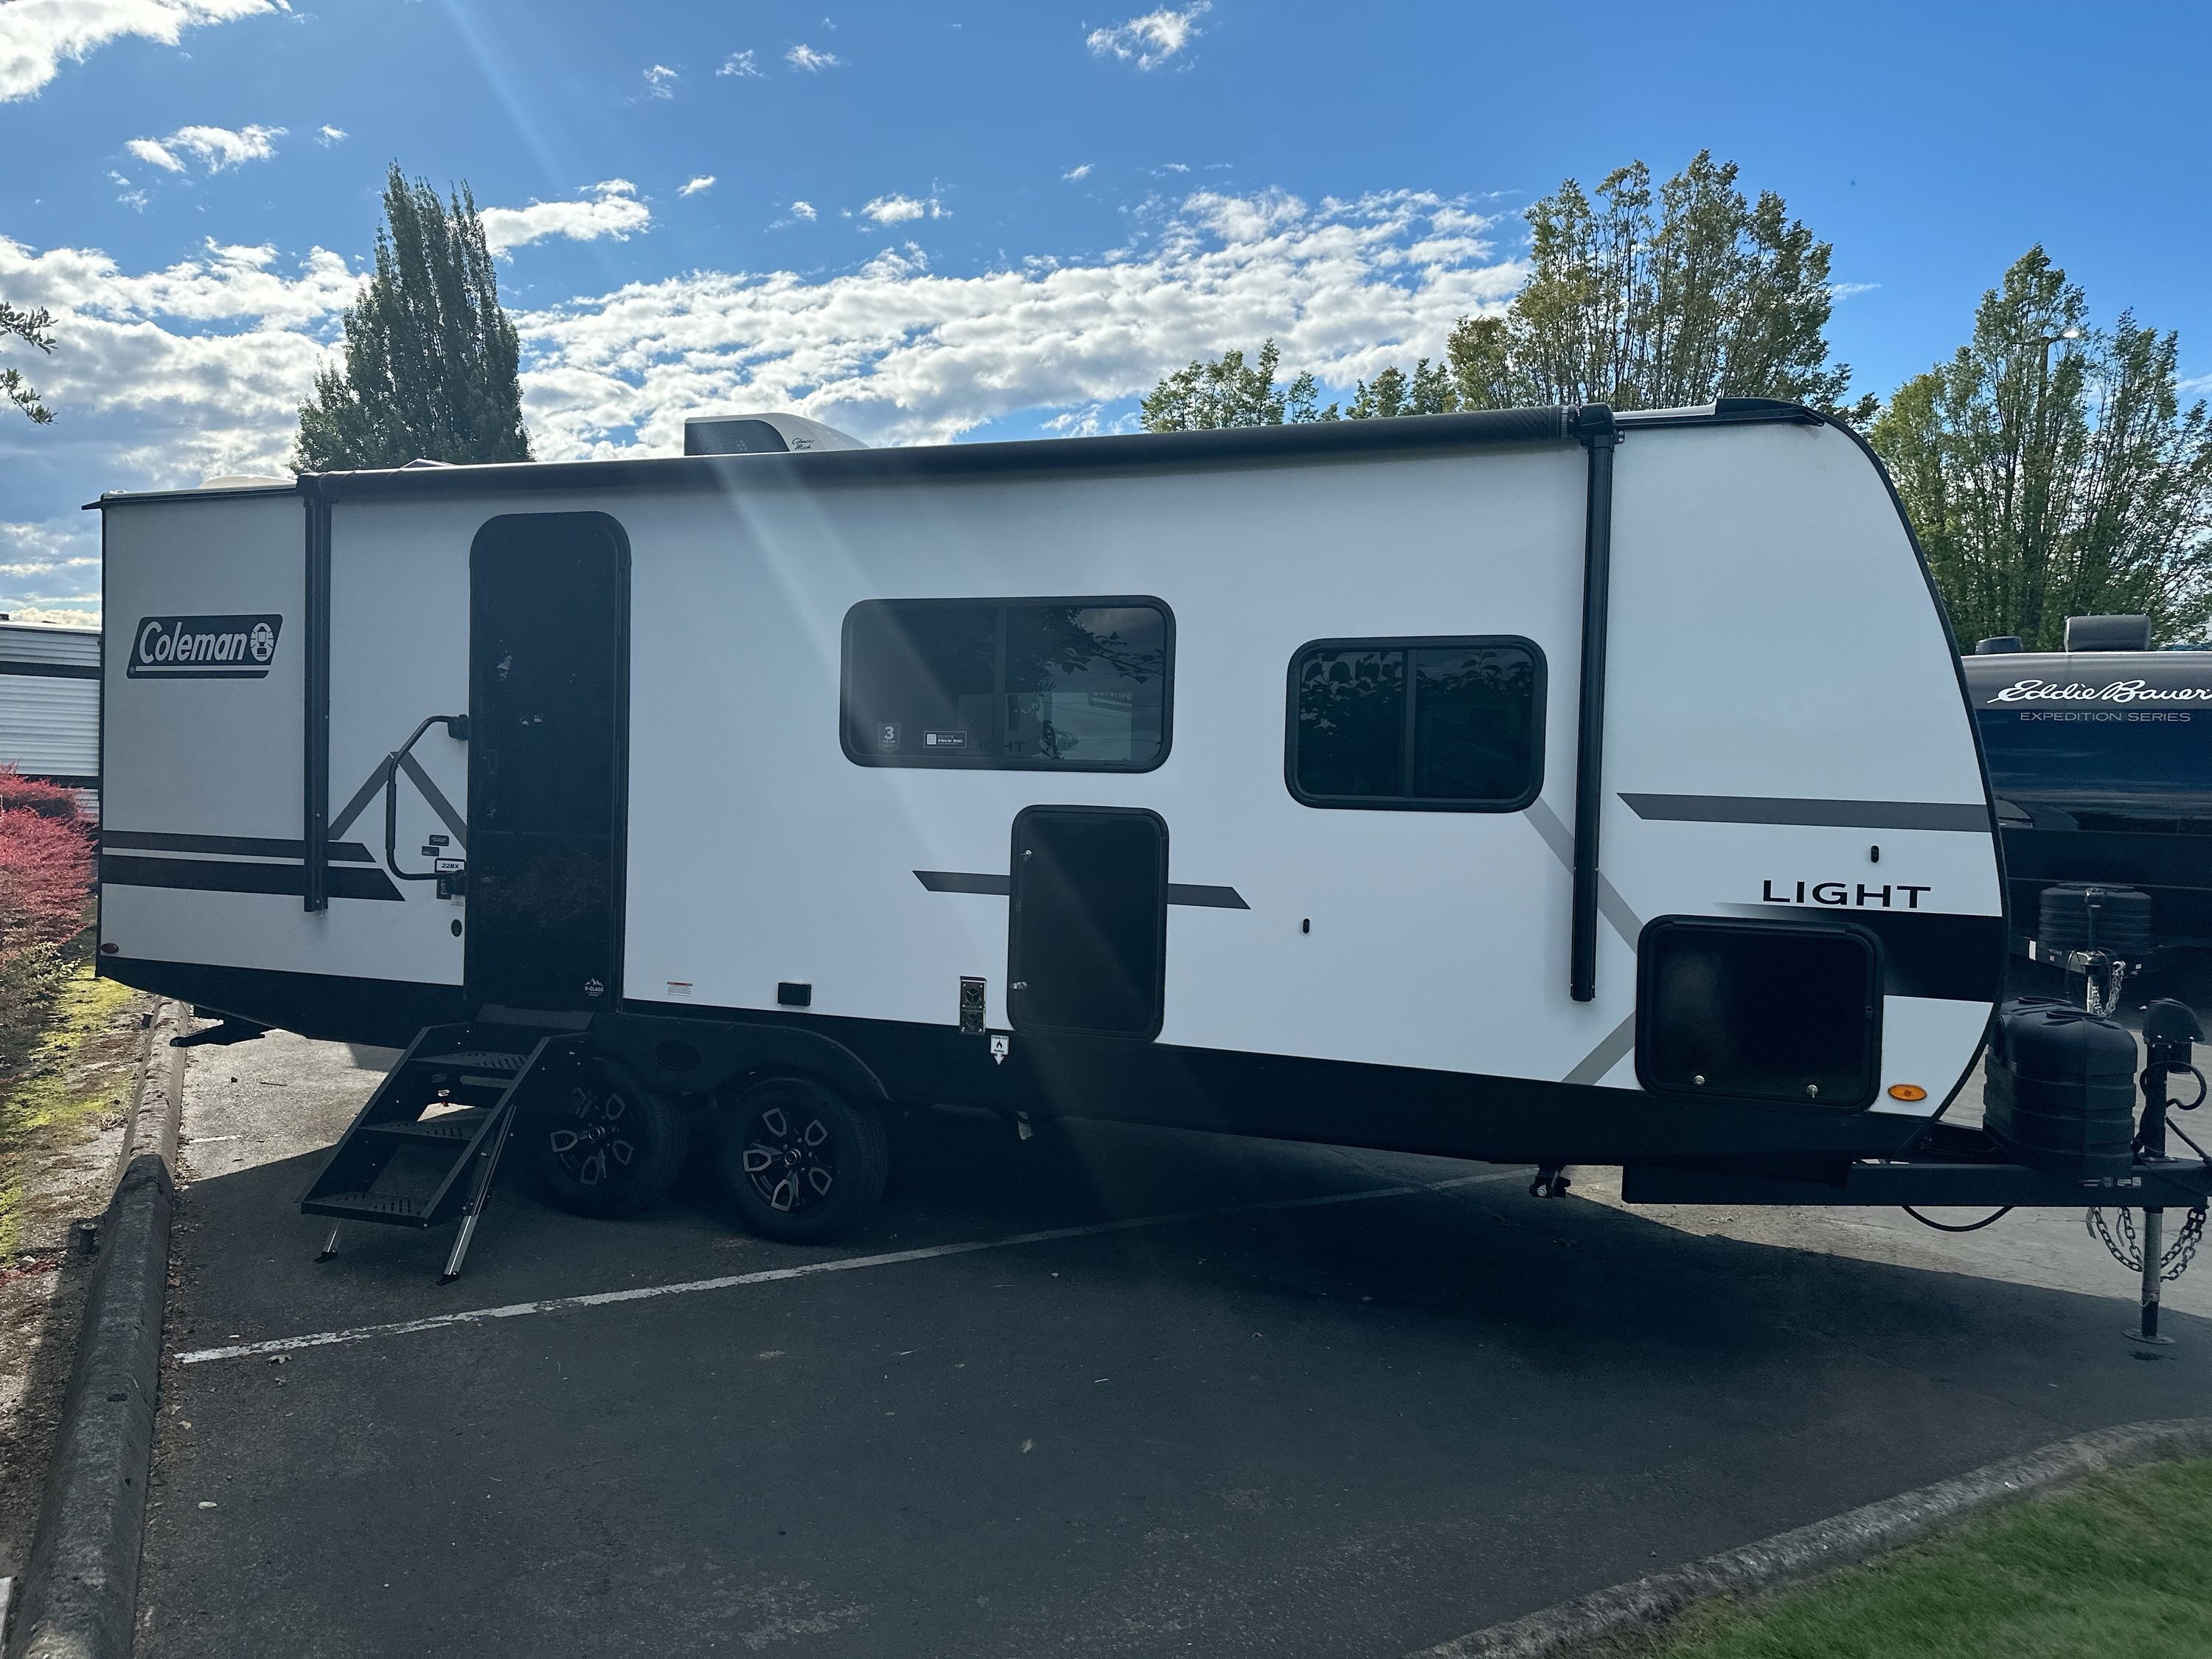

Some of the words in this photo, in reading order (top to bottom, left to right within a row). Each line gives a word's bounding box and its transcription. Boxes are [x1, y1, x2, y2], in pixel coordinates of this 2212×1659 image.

[139, 621, 248, 664] Coleman
[1986, 679, 2096, 703] Eddie
[2099, 679, 2212, 703] Bauer
[2020, 712, 2122, 722] EXPEDITION
[2127, 712, 2191, 723] SERIES
[884, 726, 894, 740] 3
[1763, 880, 1931, 908] LIGHT
